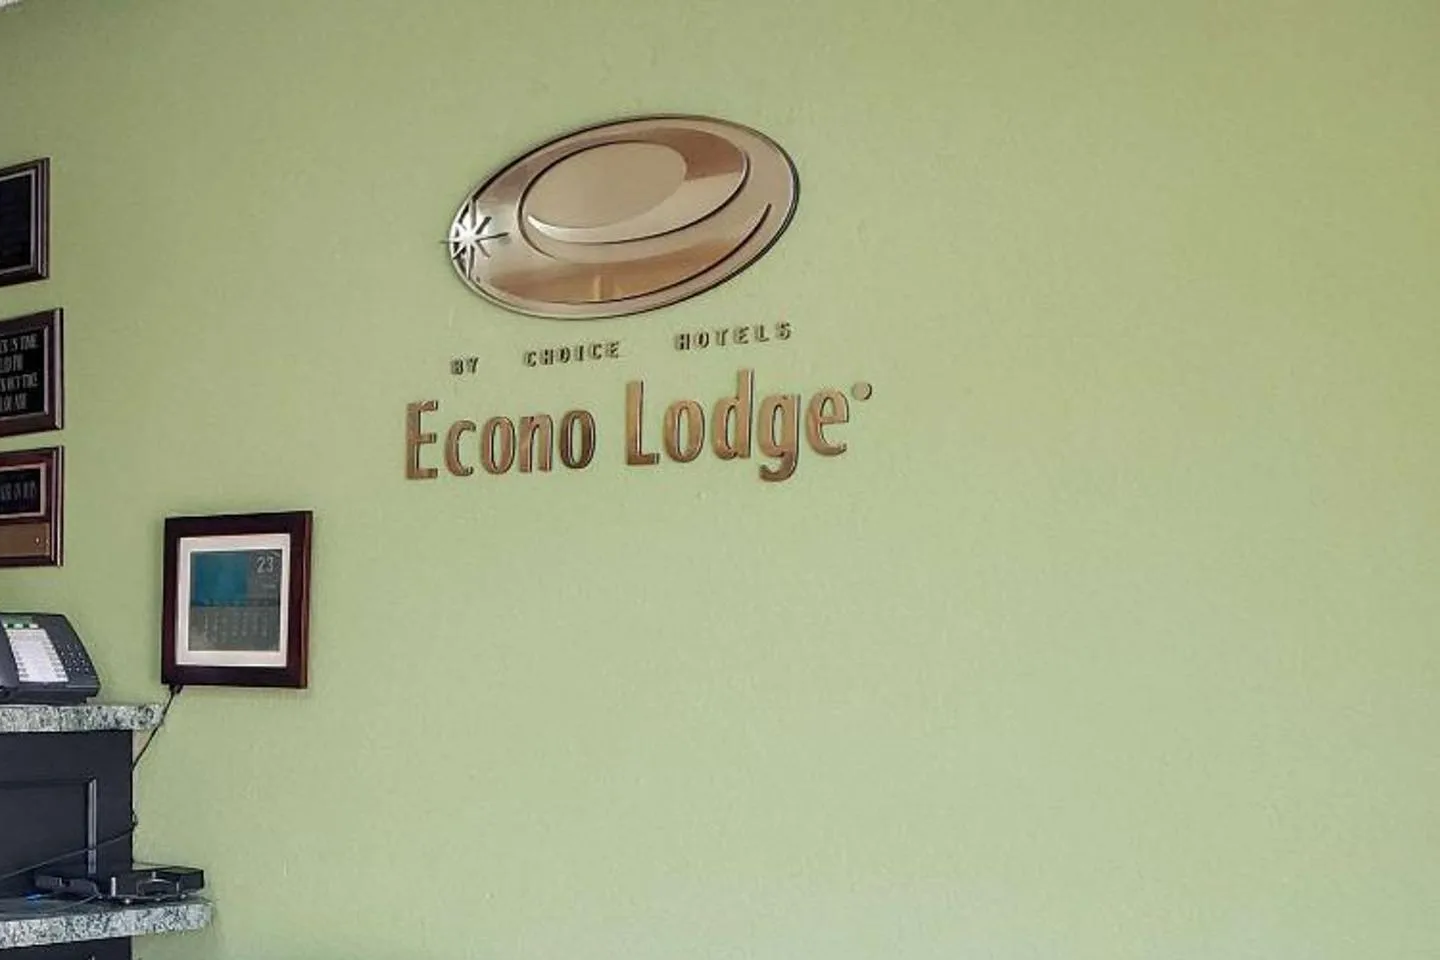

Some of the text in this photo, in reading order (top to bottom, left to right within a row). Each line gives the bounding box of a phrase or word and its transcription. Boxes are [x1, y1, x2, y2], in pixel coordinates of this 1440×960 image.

[451, 322, 793, 376] BY CHOICE HOTELS
[405, 368, 850, 482] Econo Lodge
[256, 556, 275, 574] 23
